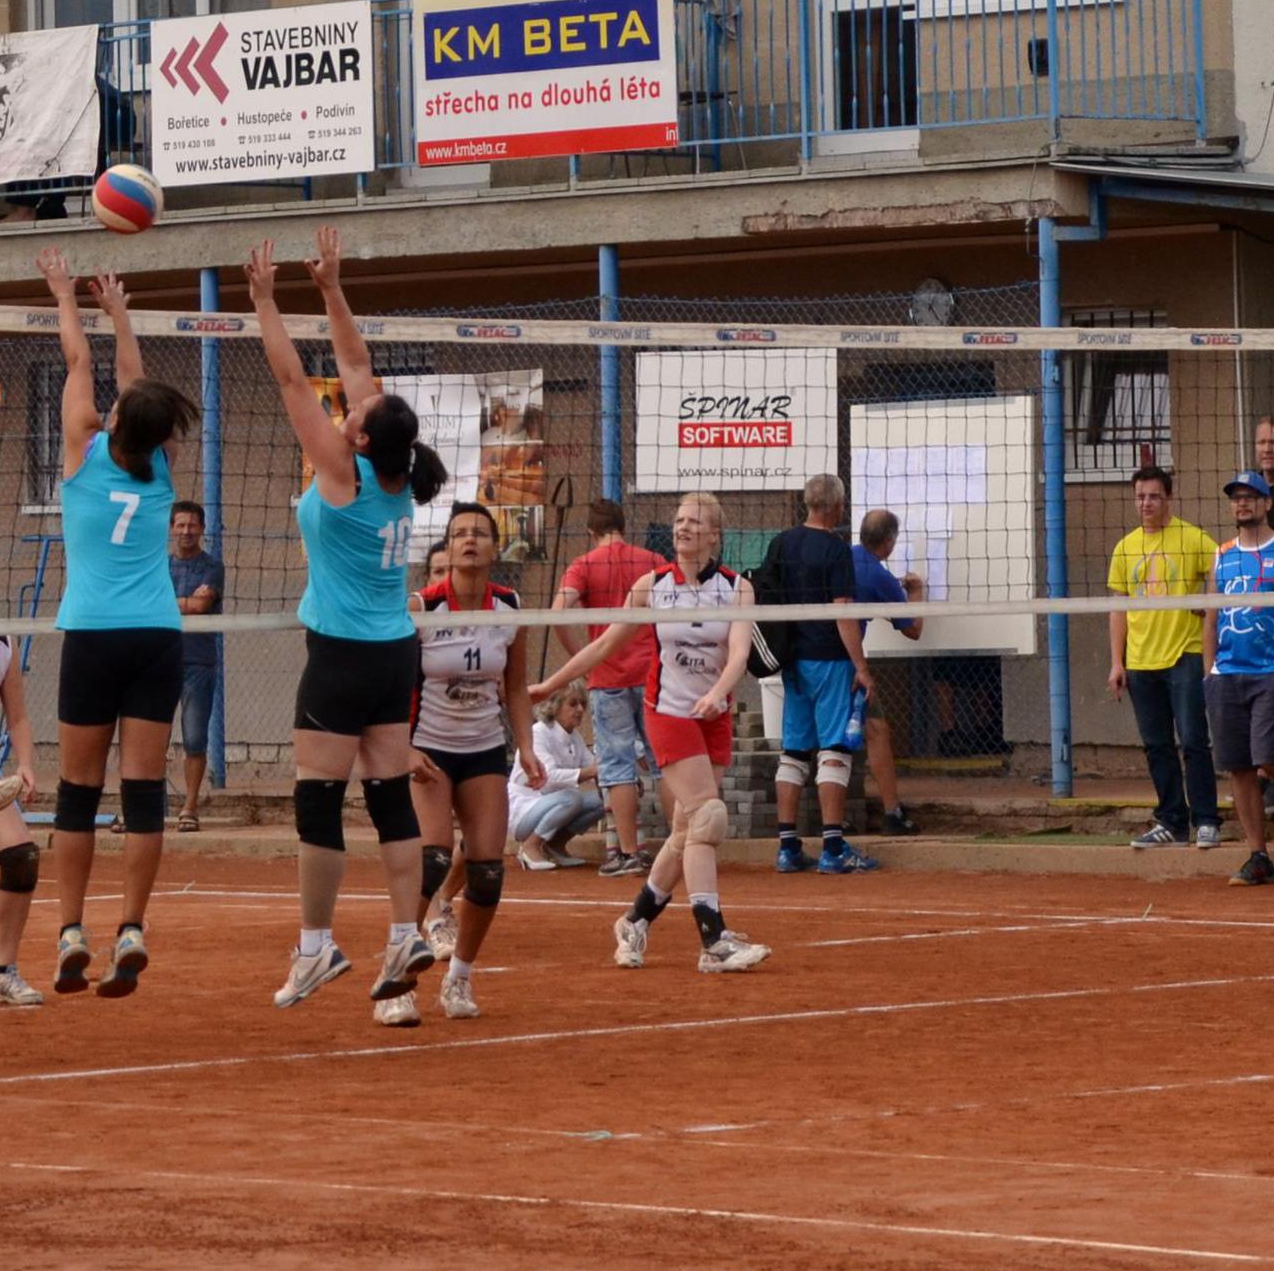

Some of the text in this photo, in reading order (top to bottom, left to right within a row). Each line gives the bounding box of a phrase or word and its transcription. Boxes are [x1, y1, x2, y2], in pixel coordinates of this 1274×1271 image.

[240, 20, 359, 54] STAVEBNINY
[433, 9, 652, 64] KM BETA
[240, 47, 361, 91] VAJBAR
[425, 75, 661, 117] střecha na dlouhá léta
[167, 115, 210, 130] Bořetice
[237, 109, 293, 126] Hustopeče
[175, 146, 347, 173] www.stavebniny-vajbar.cz
[425, 141, 507, 160] www.kmbeta.cz
[678, 391, 793, 421] ŠPINAR
[682, 425, 789, 445] SOFTWARE
[678, 465, 793, 479] www.spinar.cz
[109, 490, 141, 545] 7
[463, 647, 482, 672] 11
